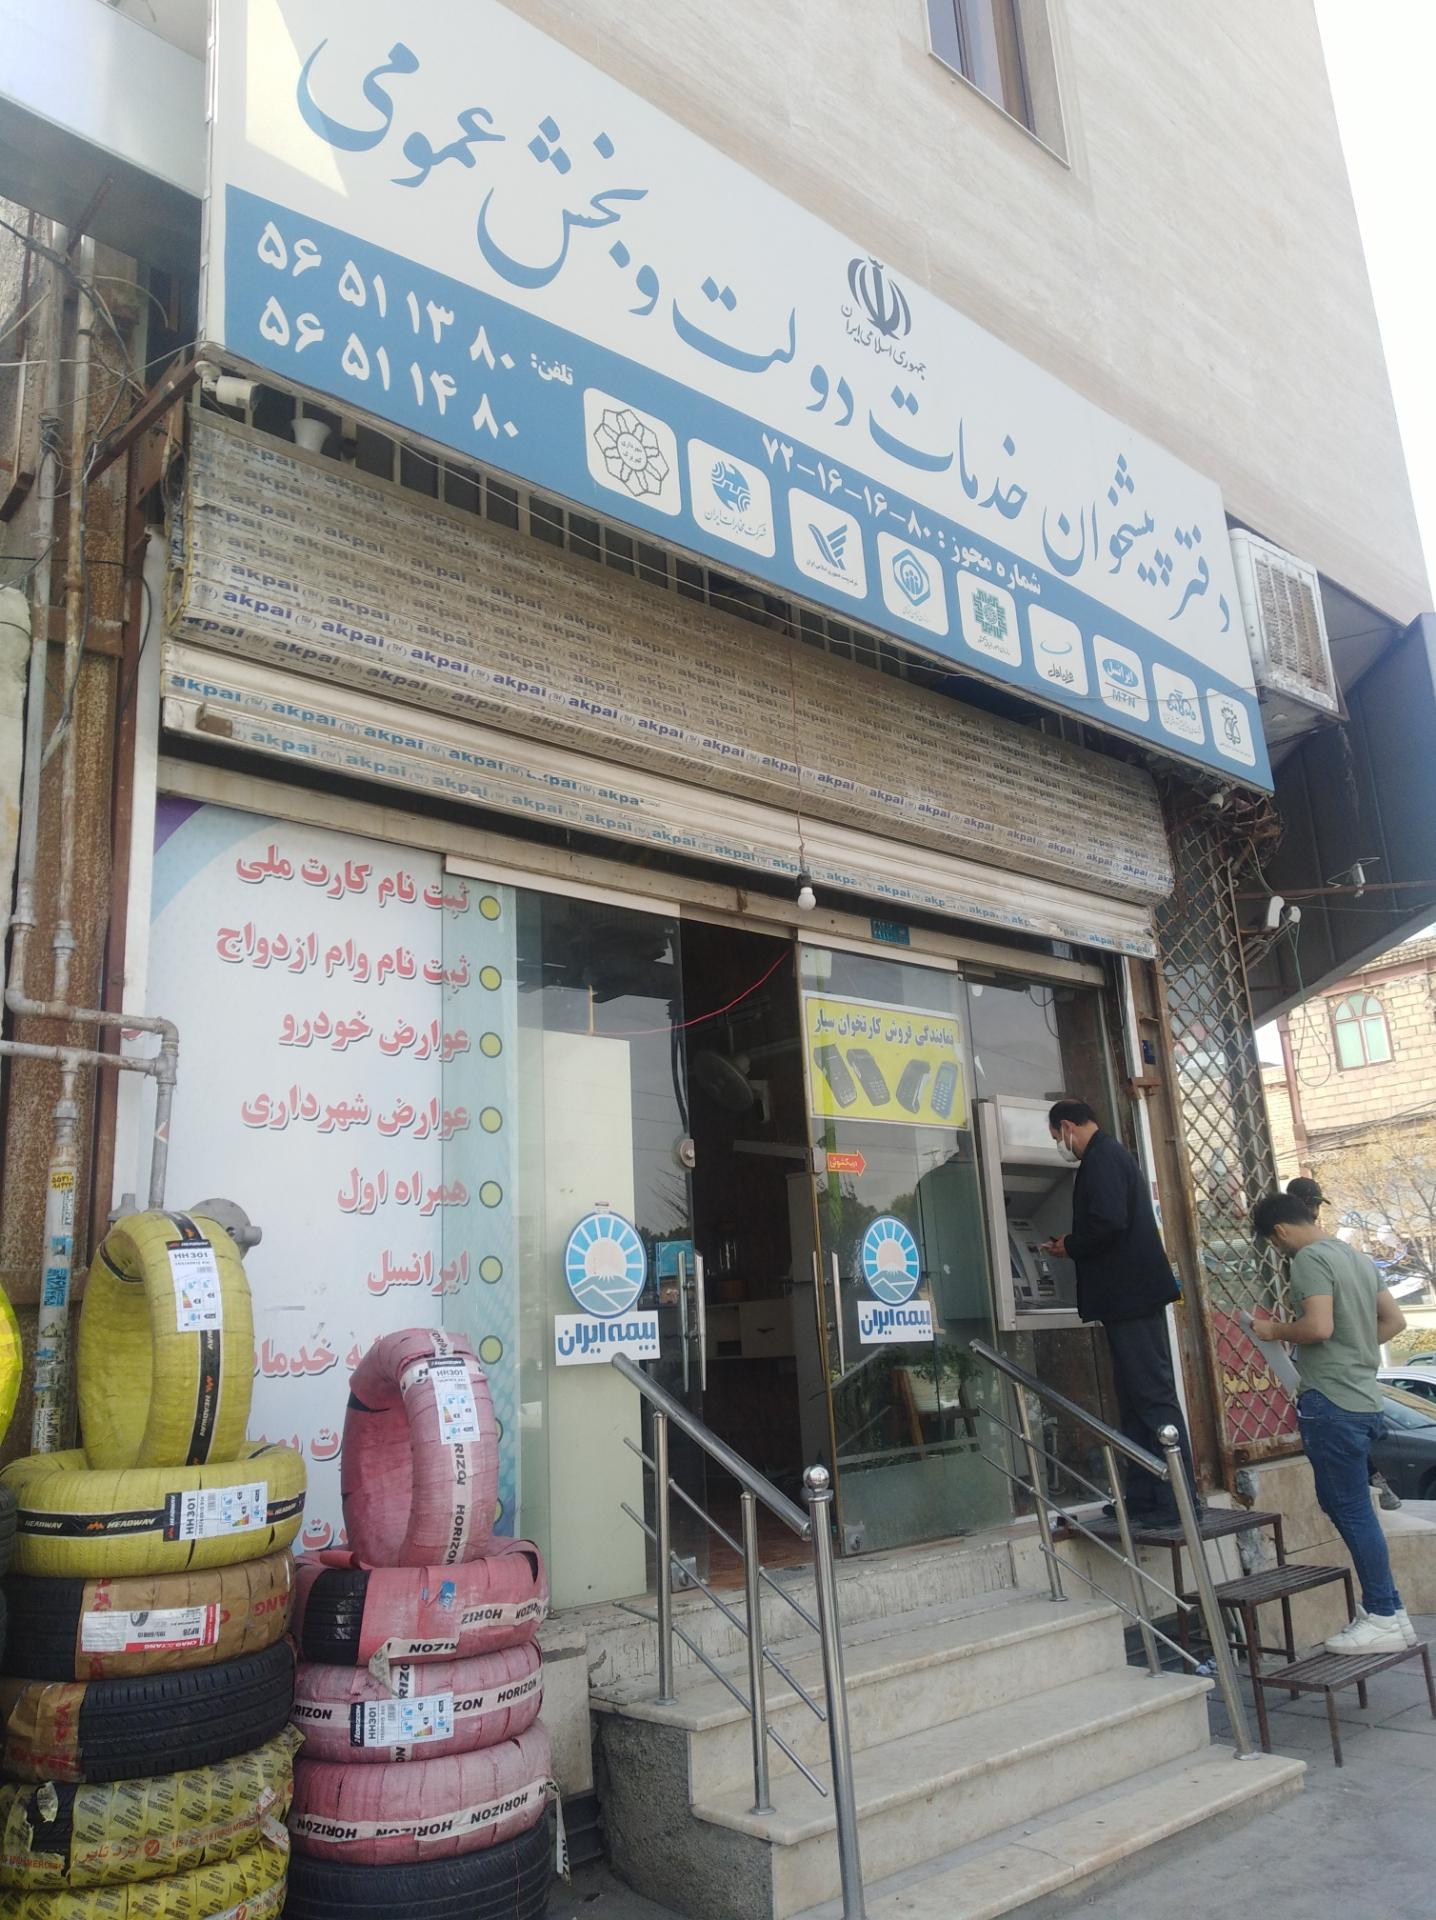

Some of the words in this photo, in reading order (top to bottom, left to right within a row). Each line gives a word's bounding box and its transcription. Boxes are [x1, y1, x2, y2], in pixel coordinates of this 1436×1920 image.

[296, 38, 506, 188] عمومی
[477, 116, 649, 289] بخش
[257, 221, 322, 277] ۵۶
[338, 260, 387, 318] ۵۱
[407, 290, 454, 343] ۱۳
[469, 325, 516, 370] ۸۰
[259, 296, 324, 353] ۵۶
[341, 332, 390, 391] ۵۱
[410, 363, 457, 416] ۱۴
[472, 393, 519, 438] ۸۰
[673, 276, 854, 426] دولت
[893, 349, 927, 381] جمهوری
[869, 385, 1028, 520] خدمات
[744, 523, 767, 540] شرکت
[1042, 453, 1173, 587] پیشخوان
[951, 537, 992, 572] مجوز
[1168, 524, 1230, 633] دفتر
[1112, 689, 1136, 708] MTN
[170, 674, 242, 703] akpai
[271, 701, 338, 727] akpai
[364, 726, 424, 750] akpai
[448, 750, 504, 771] akpai
[223, 591, 292, 620] akpai
[321, 619, 385, 648] akpai
[410, 647, 470, 675] akpai
[493, 673, 547, 698] akpai
[568, 697, 618, 720] akpai
[638, 717, 684, 740] akpai
[702, 738, 745, 759] akpai
[762, 755, 800, 775] akpai
[817, 773, 854, 792] akpai
[869, 788, 905, 807] akpai
[918, 802, 951, 820] akpai
[963, 816, 995, 834] akpai
[1007, 828, 1036, 845] akpai
[1047, 839, 1075, 858] akpai
[1086, 851, 1113, 868] akpai
[1122, 862, 1149, 879] akpai
[251, 729, 318, 756] akpai
[344, 754, 406, 777] akpai
[431, 774, 489, 798] akpai
[511, 793, 564, 816] akpai
[584, 812, 633, 832] akpai
[651, 829, 697, 848] akpai
[714, 844, 756, 862] akpai
[772, 858, 810, 876] akpai
[876, 883, 912, 899] akpai
[1089, 932, 1115, 946] akpai
[236, 844, 292, 883] ملی
[301, 858, 371, 898] کارت
[378, 870, 416, 906] نام
[423, 882, 471, 919] ثبت
[216, 921, 317, 972] ازدواج
[325, 938, 370, 980] وام
[377, 947, 416, 984] نام
[423, 956, 471, 993] ثبت
[278, 1008, 371, 1050] خودرو
[379, 1018, 470, 1060] عوارض
[815, 1008, 835, 1033] سیار
[838, 1012, 882, 1040] کارتخوان
[885, 1020, 912, 1045] فروش
[915, 1025, 954, 1048] نمایندگی
[241, 1084, 370, 1134] شهرداری
[377, 1097, 470, 1139] عوارض
[337, 1167, 388, 1214] اول
[394, 1170, 470, 1216] همراه
[367, 1250, 470, 1295] ایرانسل
[557, 1322, 606, 1356] ایران
[605, 1321, 656, 1352] بیمه
[861, 1308, 896, 1336] ایران
[895, 1306, 931, 1335] بیمه
[200, 1395, 210, 1437] HEADWAY
[454, 1443, 467, 1486] RIZON
[24, 1519, 63, 1530] HEADWAY
[106, 1517, 156, 1530] HEADWAY
[186, 1497, 195, 1535] HH301
[462, 1608, 503, 1625] HORIZ
[497, 1679, 537, 1704] HORIZON
[294, 1705, 332, 1720] RIZON
[368, 1706, 377, 1740] HH301
[470, 1792, 528, 1825] HORIZON
[297, 1818, 357, 1839] HORIZON
